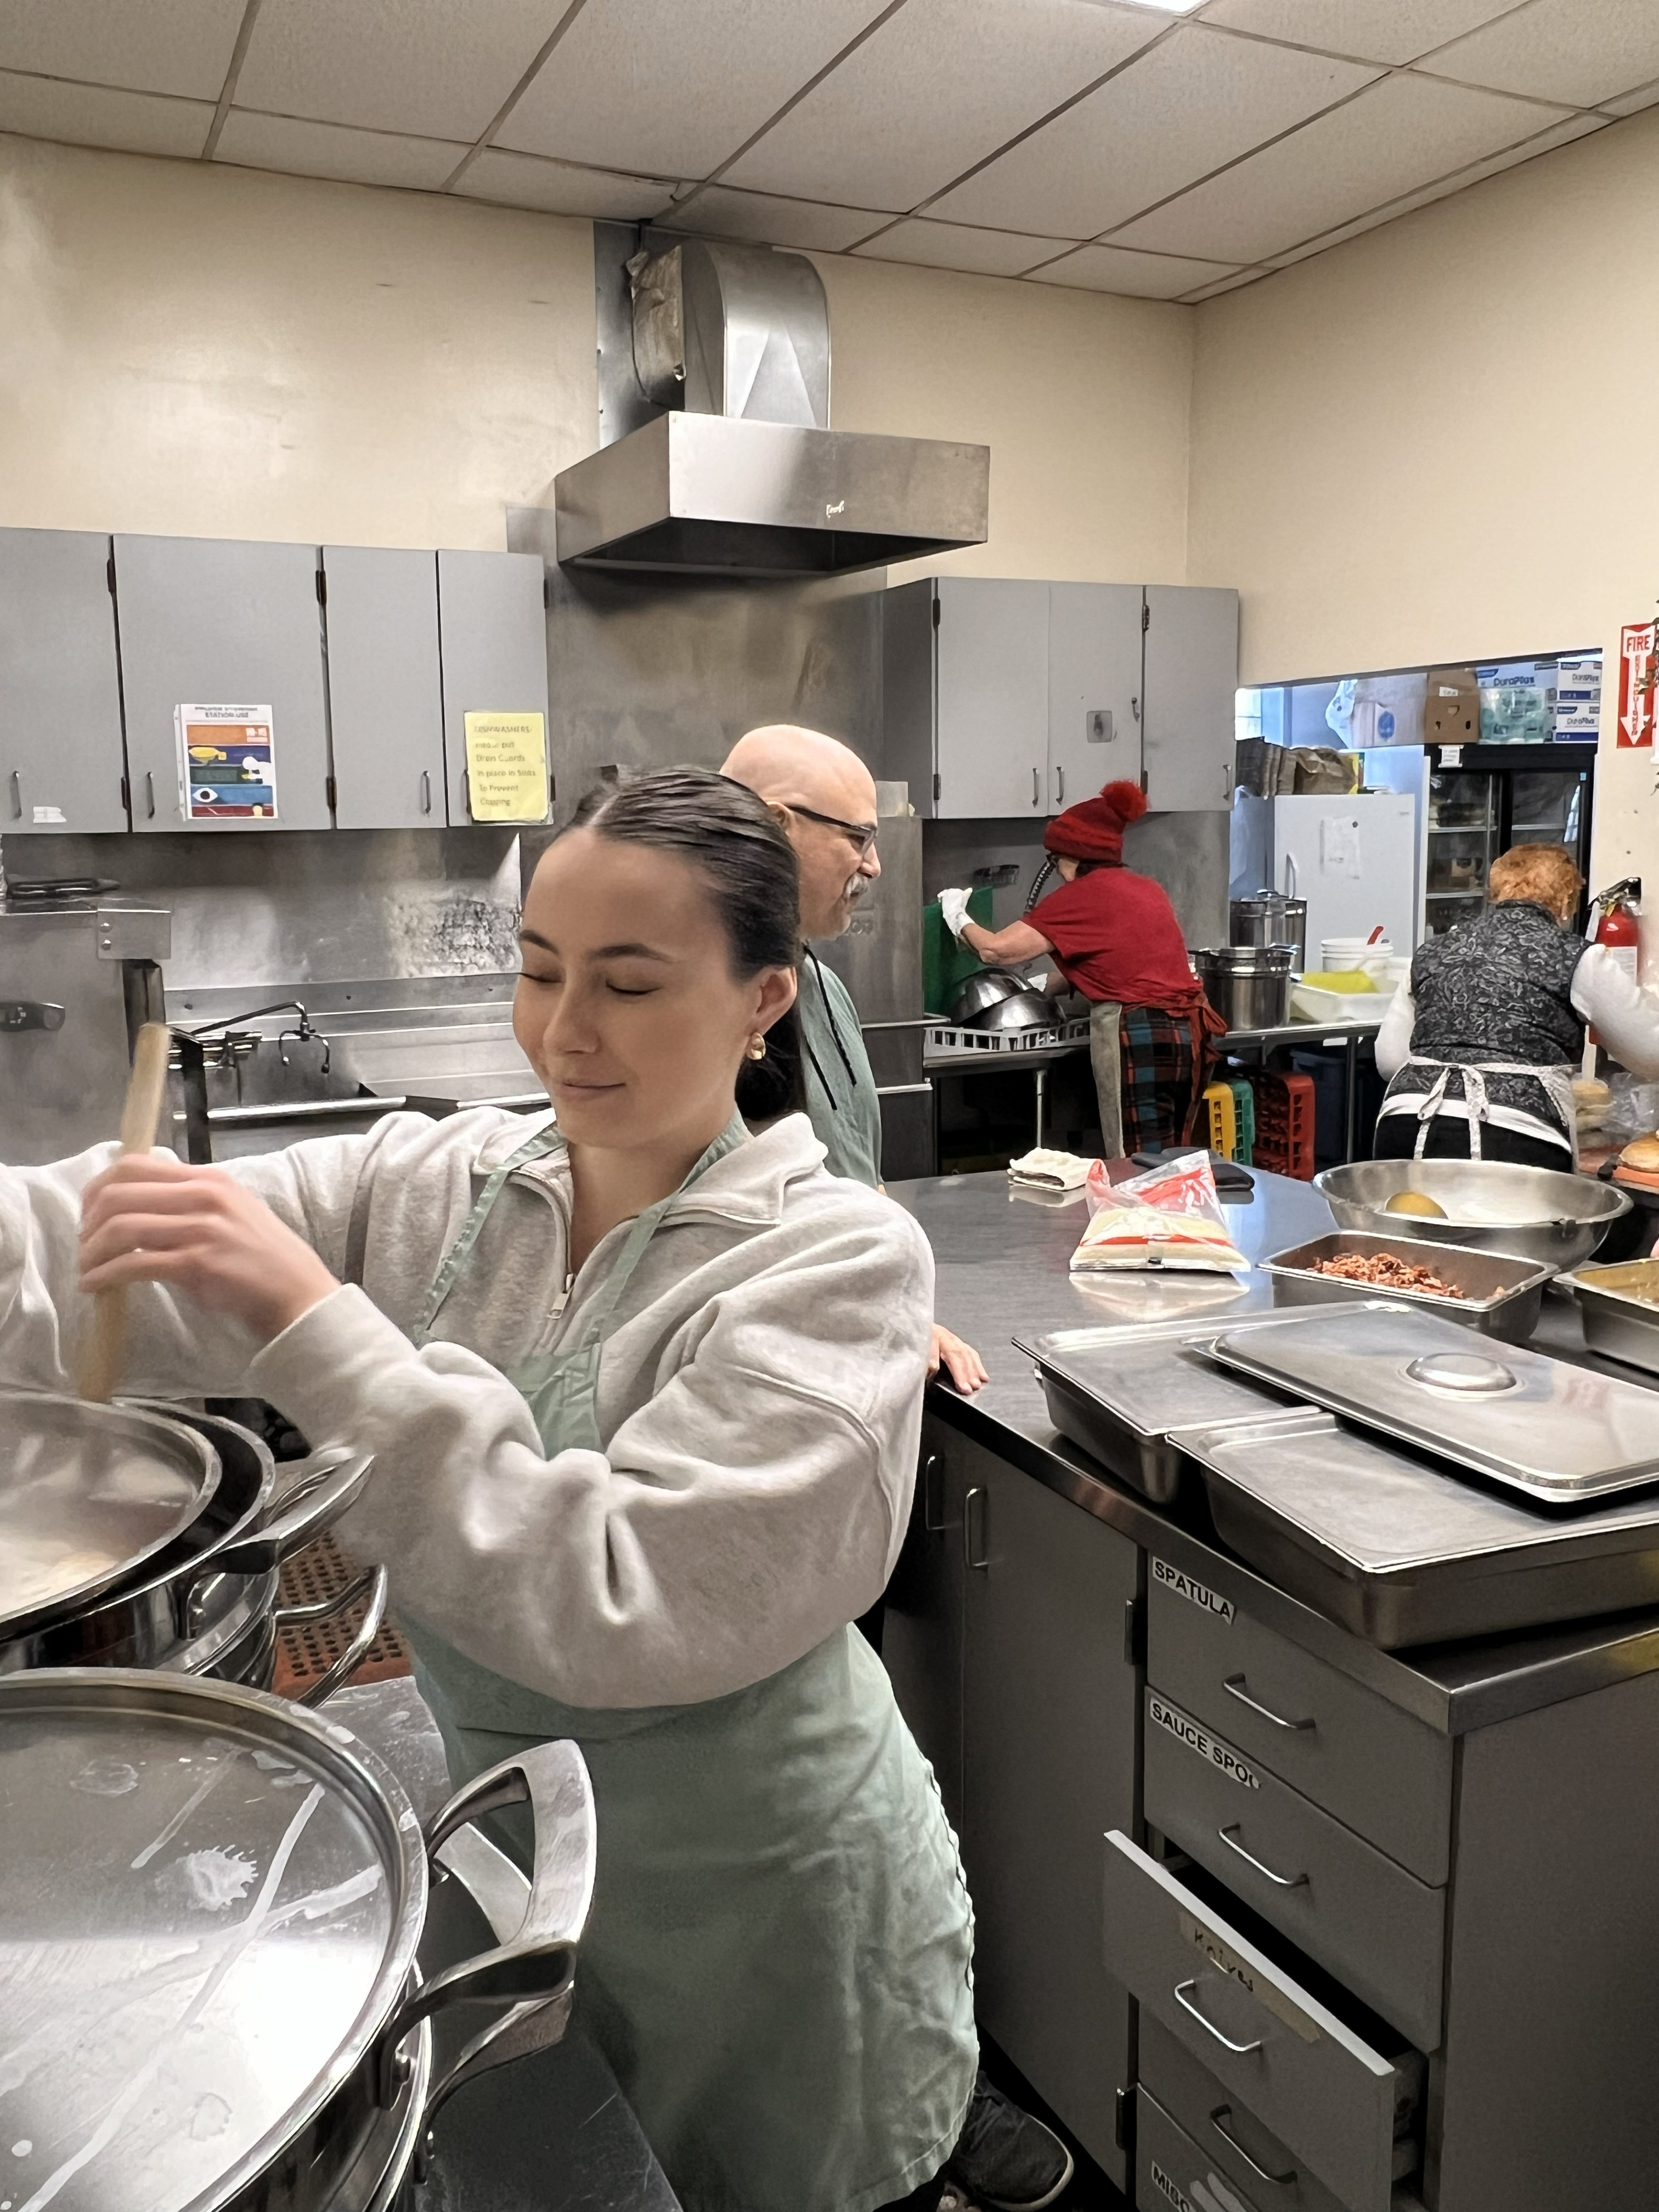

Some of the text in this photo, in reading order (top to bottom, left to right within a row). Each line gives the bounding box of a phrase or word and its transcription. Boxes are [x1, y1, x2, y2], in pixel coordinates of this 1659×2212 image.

[1627, 635, 1651, 652] FIRE
[1155, 1561, 1231, 1618] SPATULA
[1152, 1703, 1207, 1755] SAUCE
